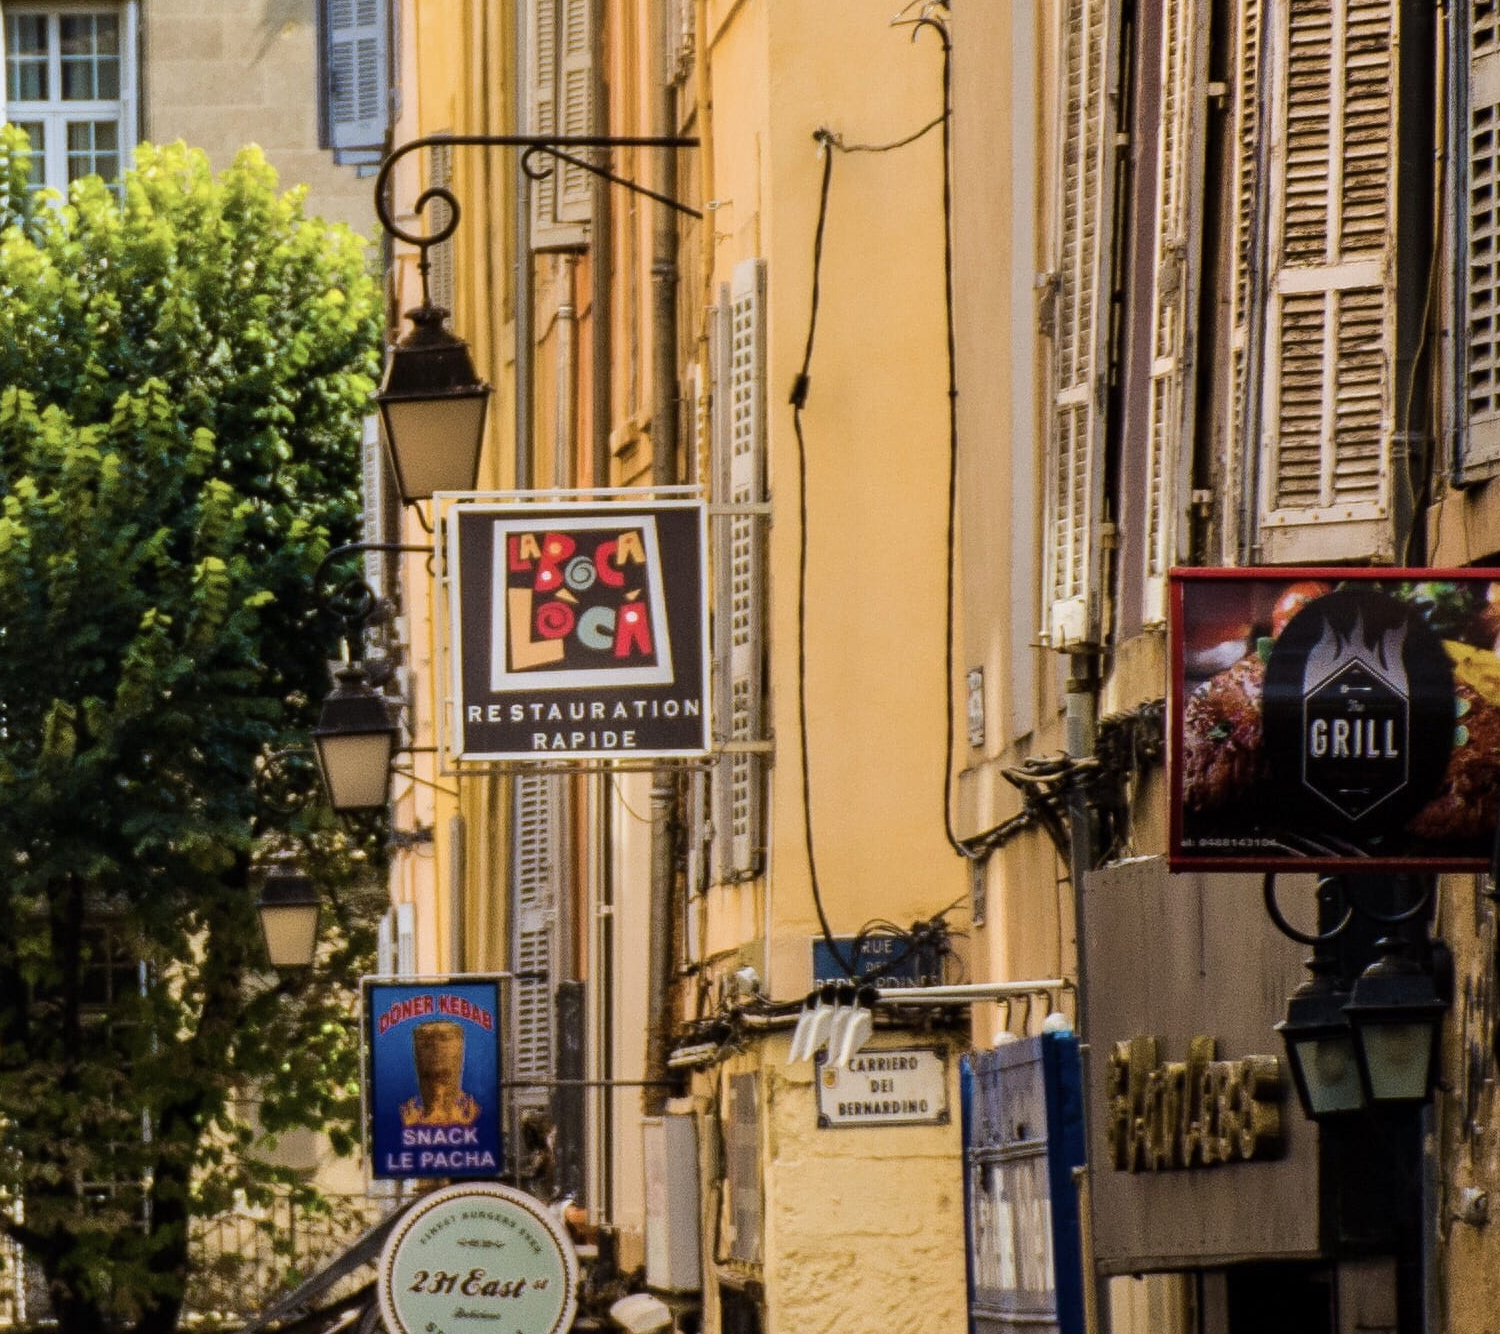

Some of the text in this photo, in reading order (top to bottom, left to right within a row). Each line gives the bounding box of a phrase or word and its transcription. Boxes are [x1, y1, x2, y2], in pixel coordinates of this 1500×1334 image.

[466, 698, 700, 724] RESTAURATION
[531, 730, 637, 750] RAPIDE
[1309, 716, 1400, 760] GRILL
[859, 938, 893, 955] RUE
[437, 994, 495, 1032] KEBAB
[847, 1054, 920, 1074] CARRIERO
[870, 1077, 895, 1094] DEI
[837, 1099, 930, 1117] BERNARDINO
[402, 1126, 480, 1146] SNACK
[386, 1150, 496, 1169] LE PACHA
[460, 1266, 526, 1299] East
